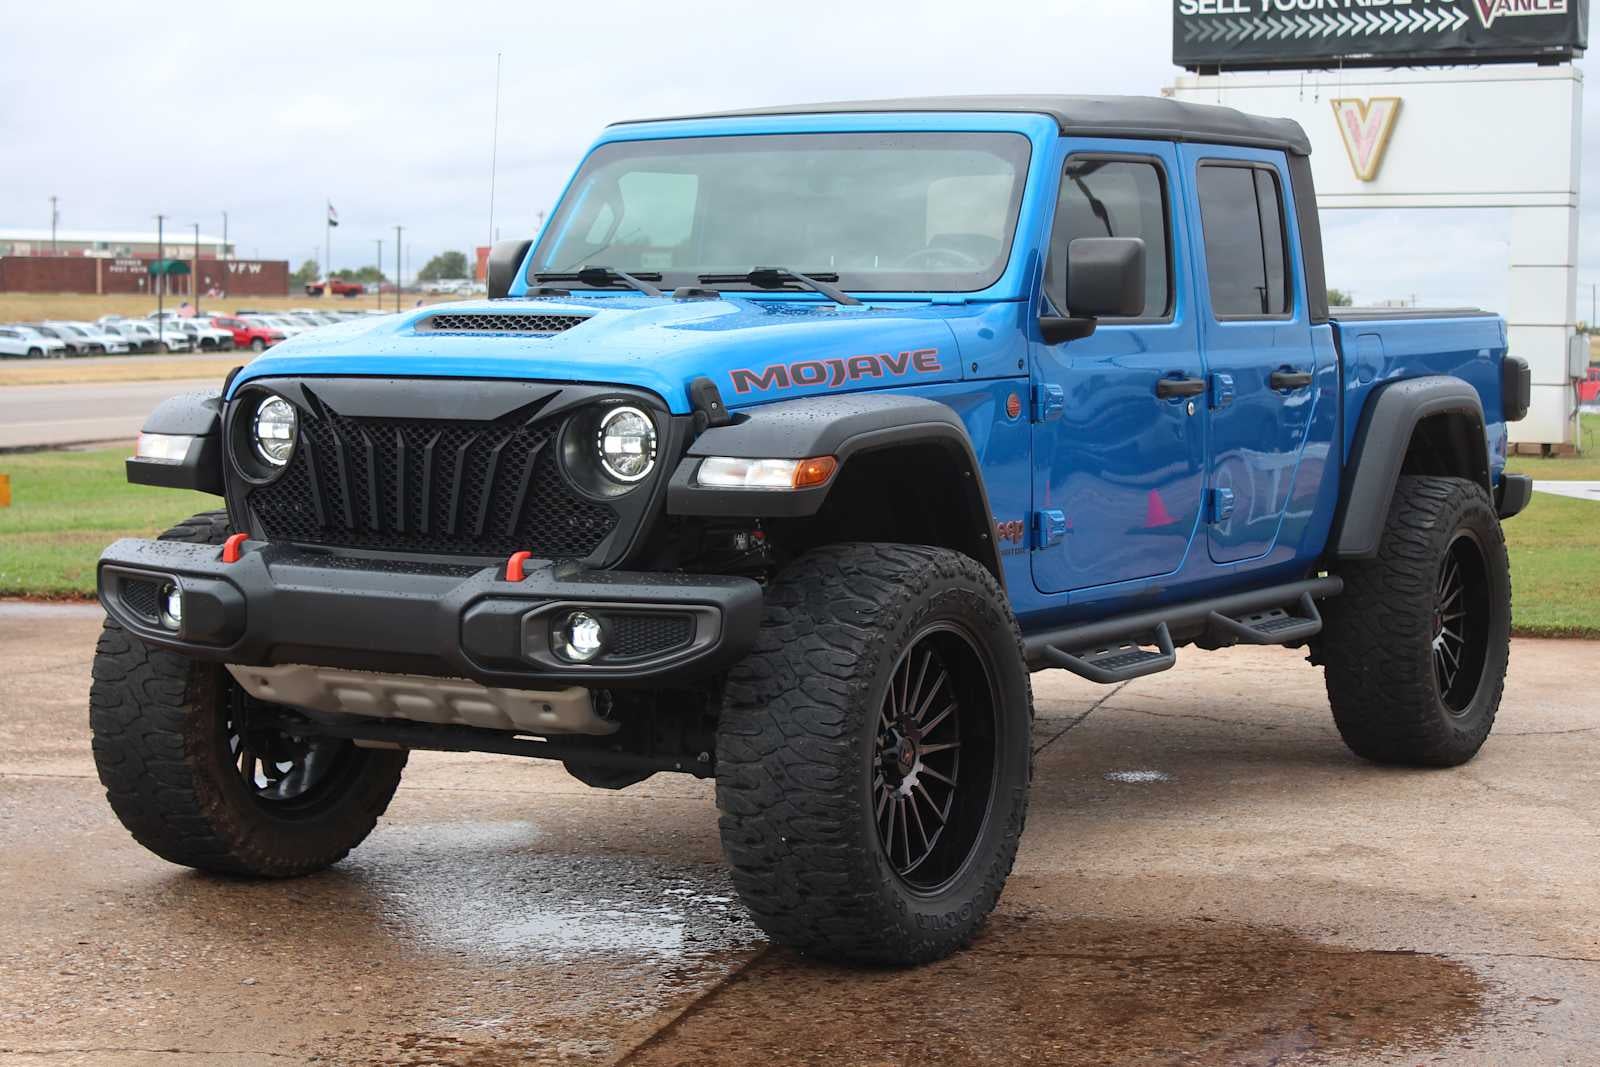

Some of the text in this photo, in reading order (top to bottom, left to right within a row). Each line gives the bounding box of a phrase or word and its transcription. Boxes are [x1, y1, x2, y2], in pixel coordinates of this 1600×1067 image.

[1329, 96, 1404, 182] V
[228, 263, 262, 274] VFW
[729, 349, 943, 394] MOJAVE
